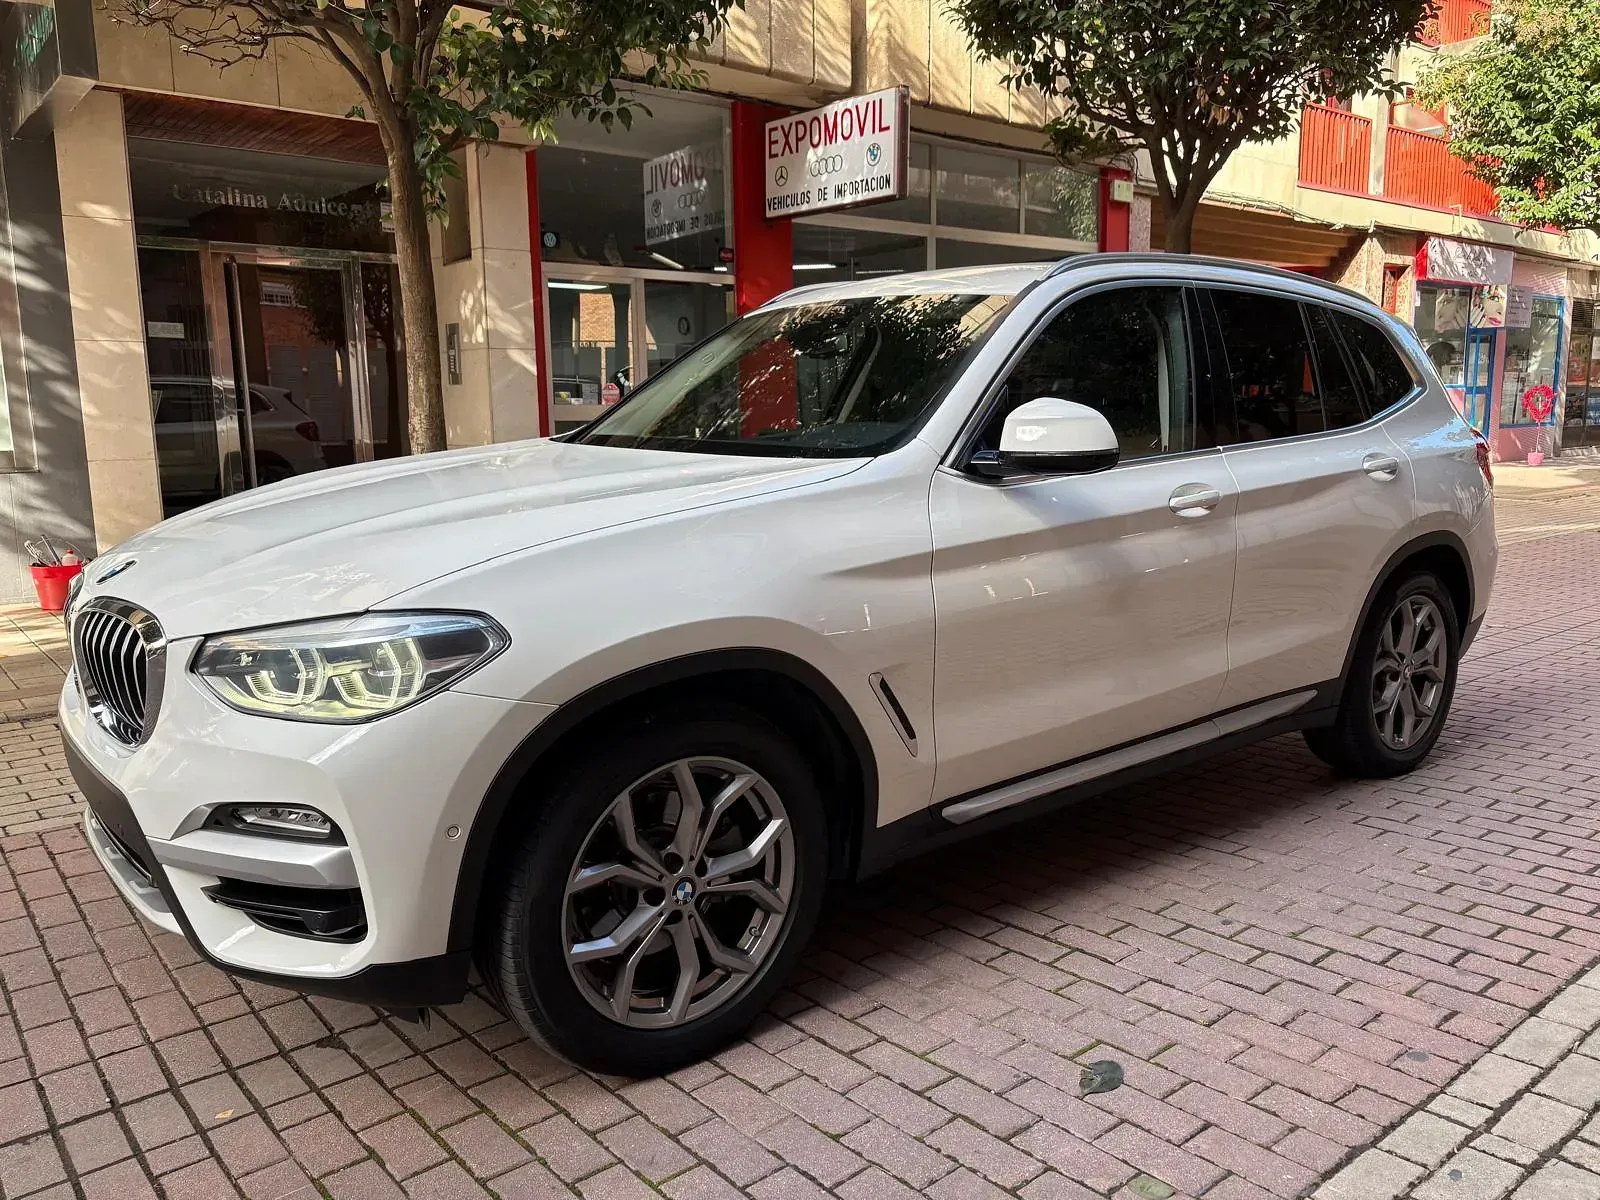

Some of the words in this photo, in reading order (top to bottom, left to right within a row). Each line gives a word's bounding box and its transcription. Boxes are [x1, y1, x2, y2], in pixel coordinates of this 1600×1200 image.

[768, 98, 891, 160] EXPOMOVIL
[172, 184, 269, 209] Catalina
[767, 190, 811, 212] VEHICULOS
[817, 187, 828, 202] DE
[834, 173, 891, 199] IMPORTACION
